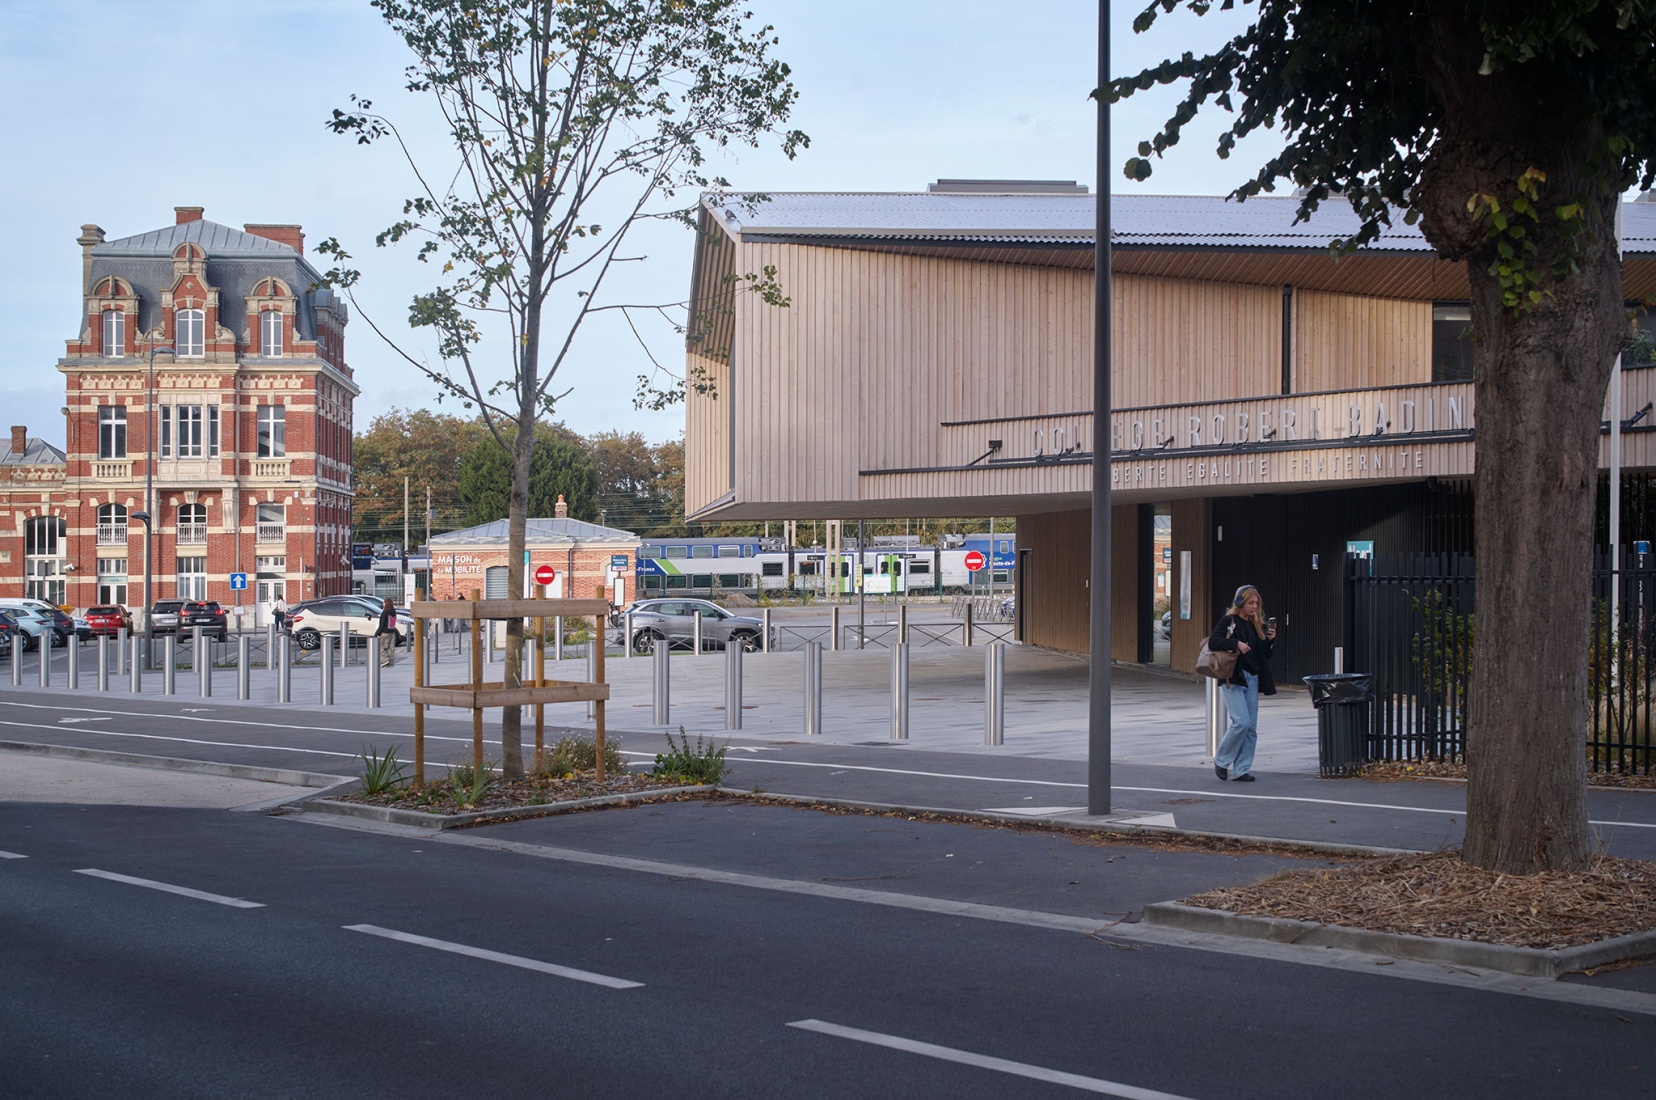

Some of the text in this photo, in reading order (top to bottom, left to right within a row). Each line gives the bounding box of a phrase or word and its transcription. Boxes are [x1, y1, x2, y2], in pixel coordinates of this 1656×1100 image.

[1033, 419, 1164, 457] COLEGE
[1188, 407, 1320, 448] ROBERT
[1112, 451, 1423, 483] BERTE EGALITE FRATERNITE
[438, 555, 473, 564] MASON
